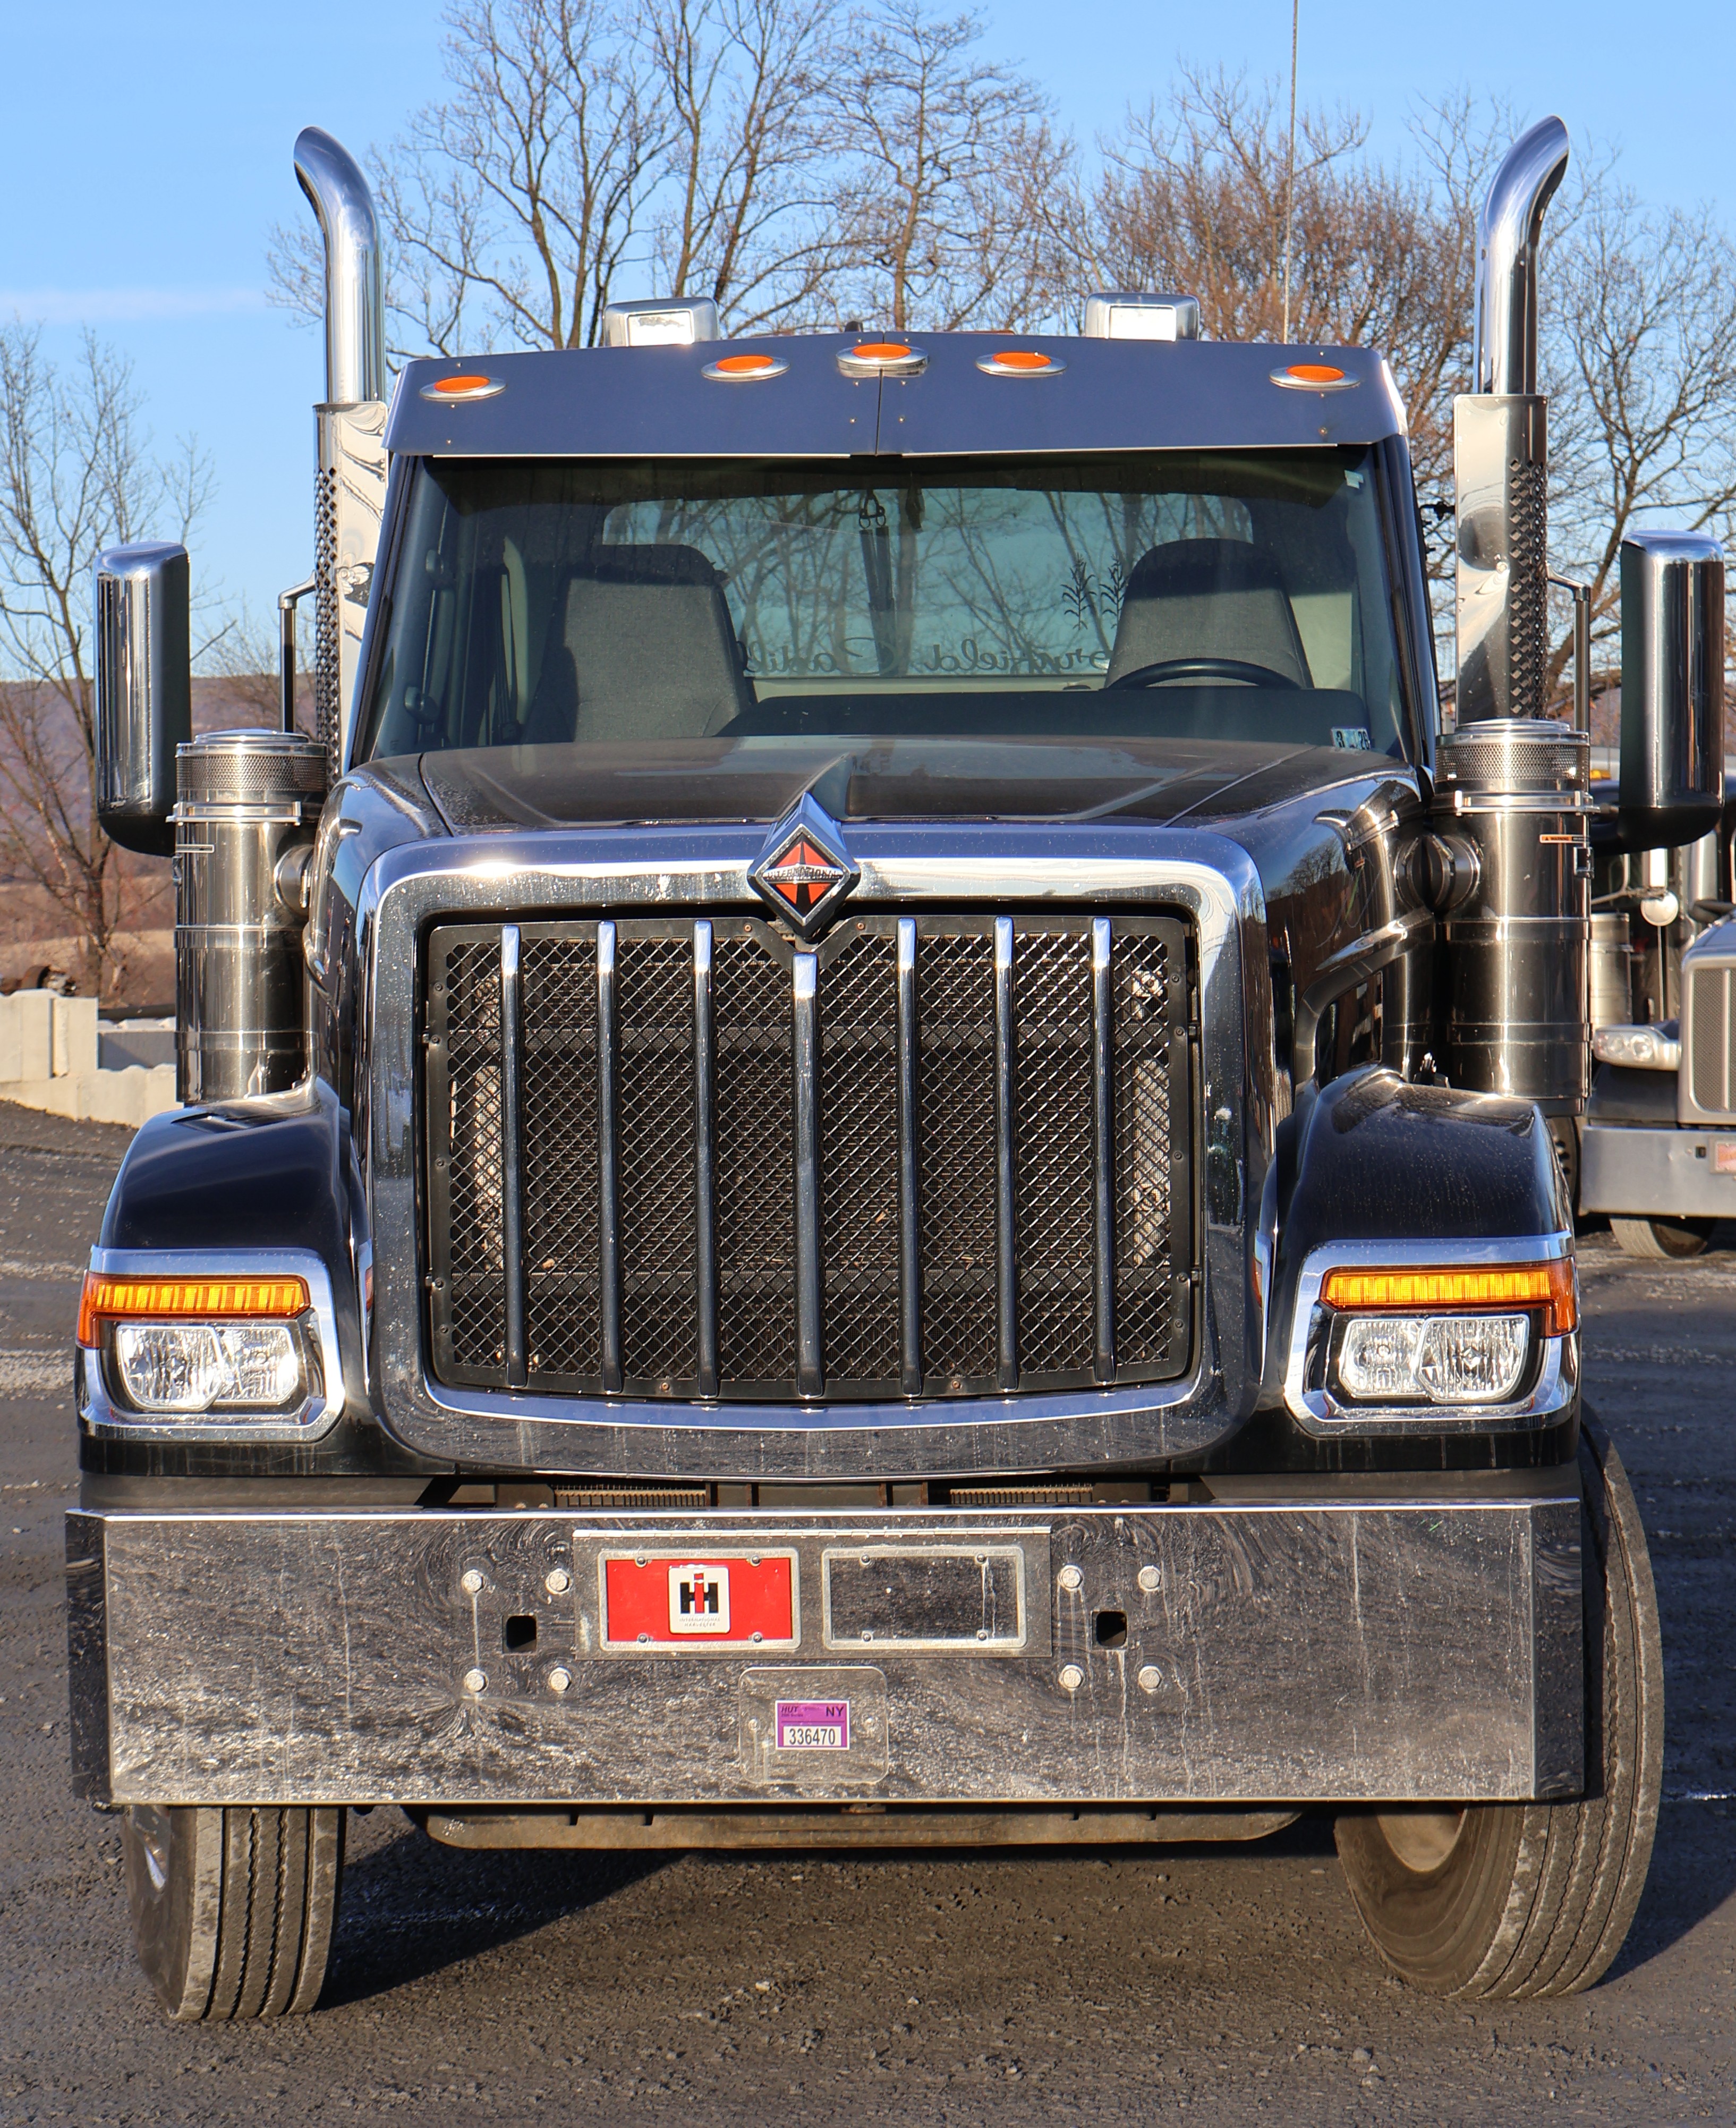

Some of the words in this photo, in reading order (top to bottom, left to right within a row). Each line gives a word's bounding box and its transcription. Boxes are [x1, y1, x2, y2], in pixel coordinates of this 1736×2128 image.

[1336, 731, 1345, 748] 3
[826, 1706, 844, 1717] NY
[789, 1728, 836, 1745] 336470
